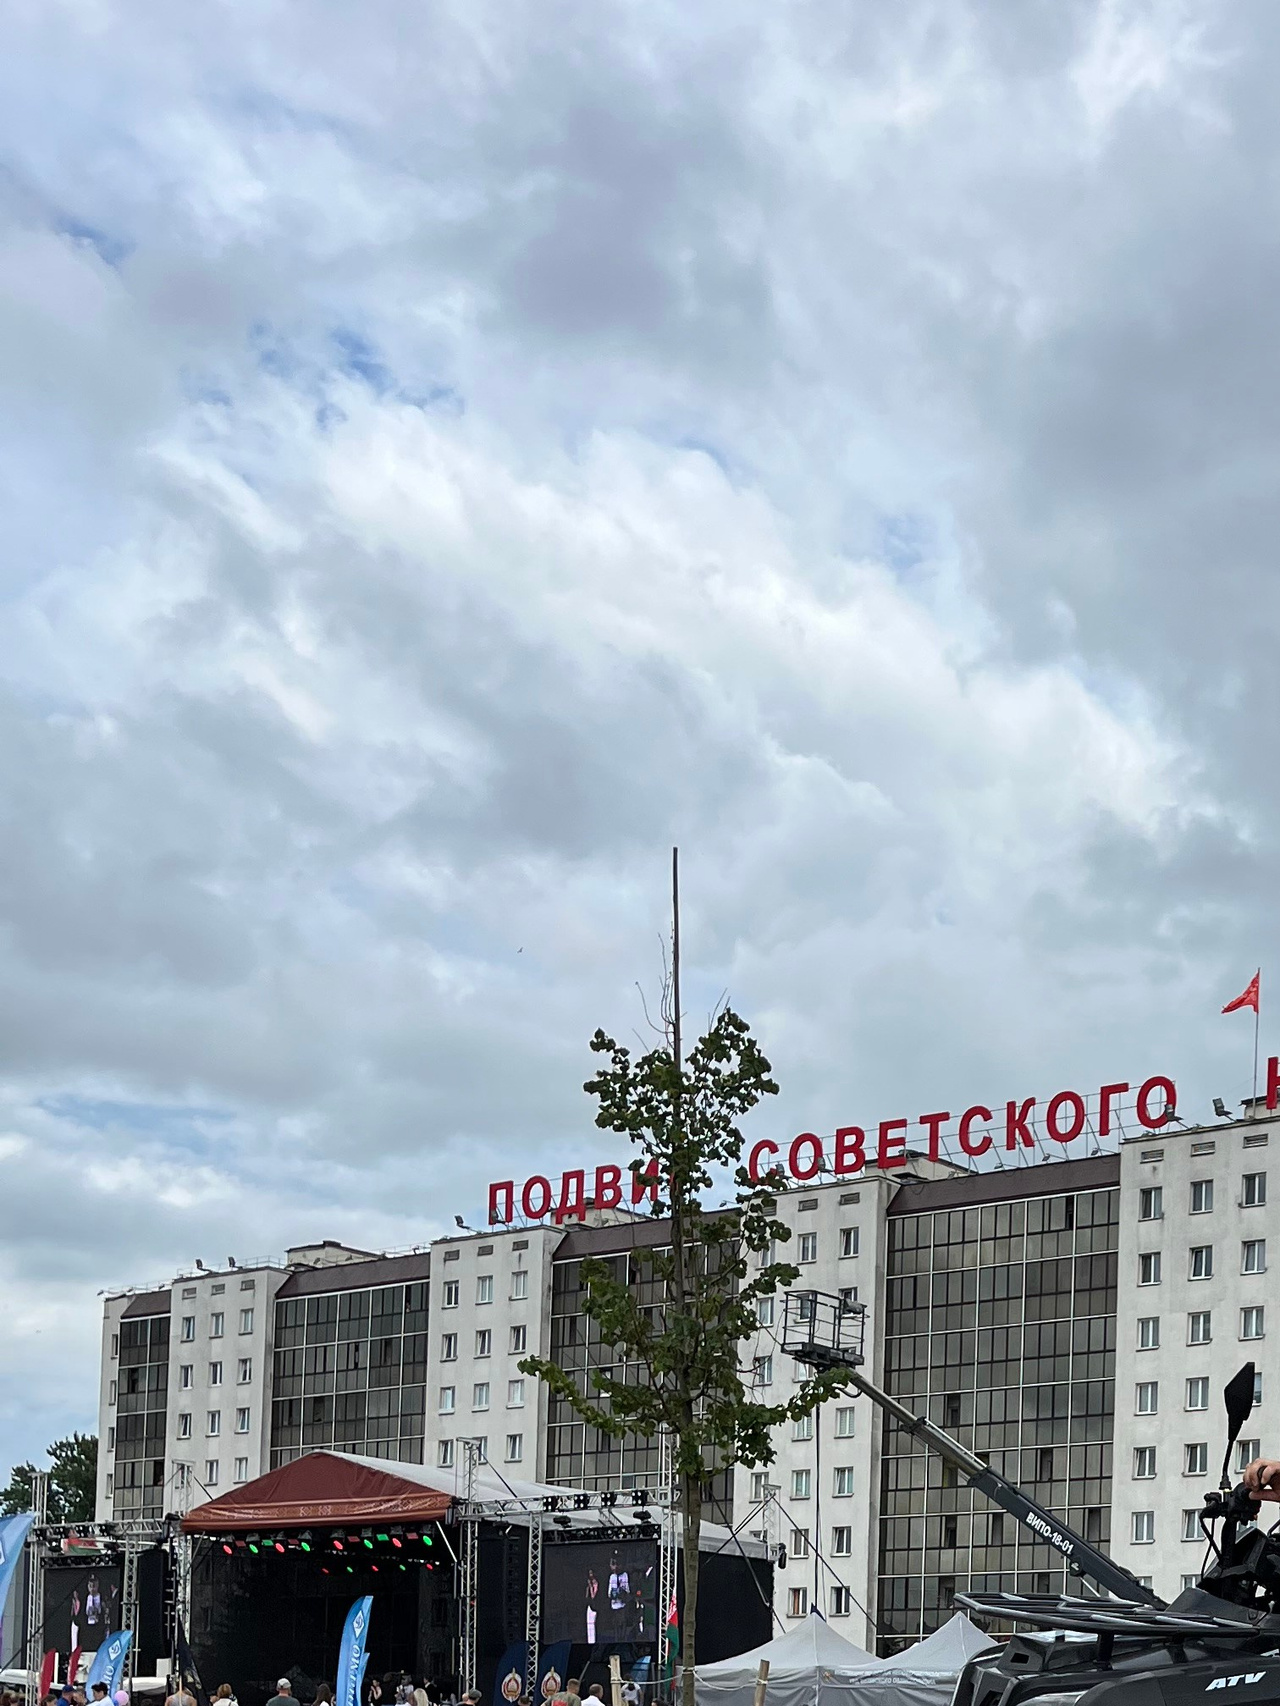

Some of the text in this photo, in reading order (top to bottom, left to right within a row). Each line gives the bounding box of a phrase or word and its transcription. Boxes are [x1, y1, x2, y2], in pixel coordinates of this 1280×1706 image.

[488, 1158, 676, 1225] ПОДВИ
[748, 1075, 1178, 1184] СОВЕТСКОГО
[1026, 1511, 1074, 1555] ВИПО-18-01
[1205, 1671, 1266, 1692] ATV
